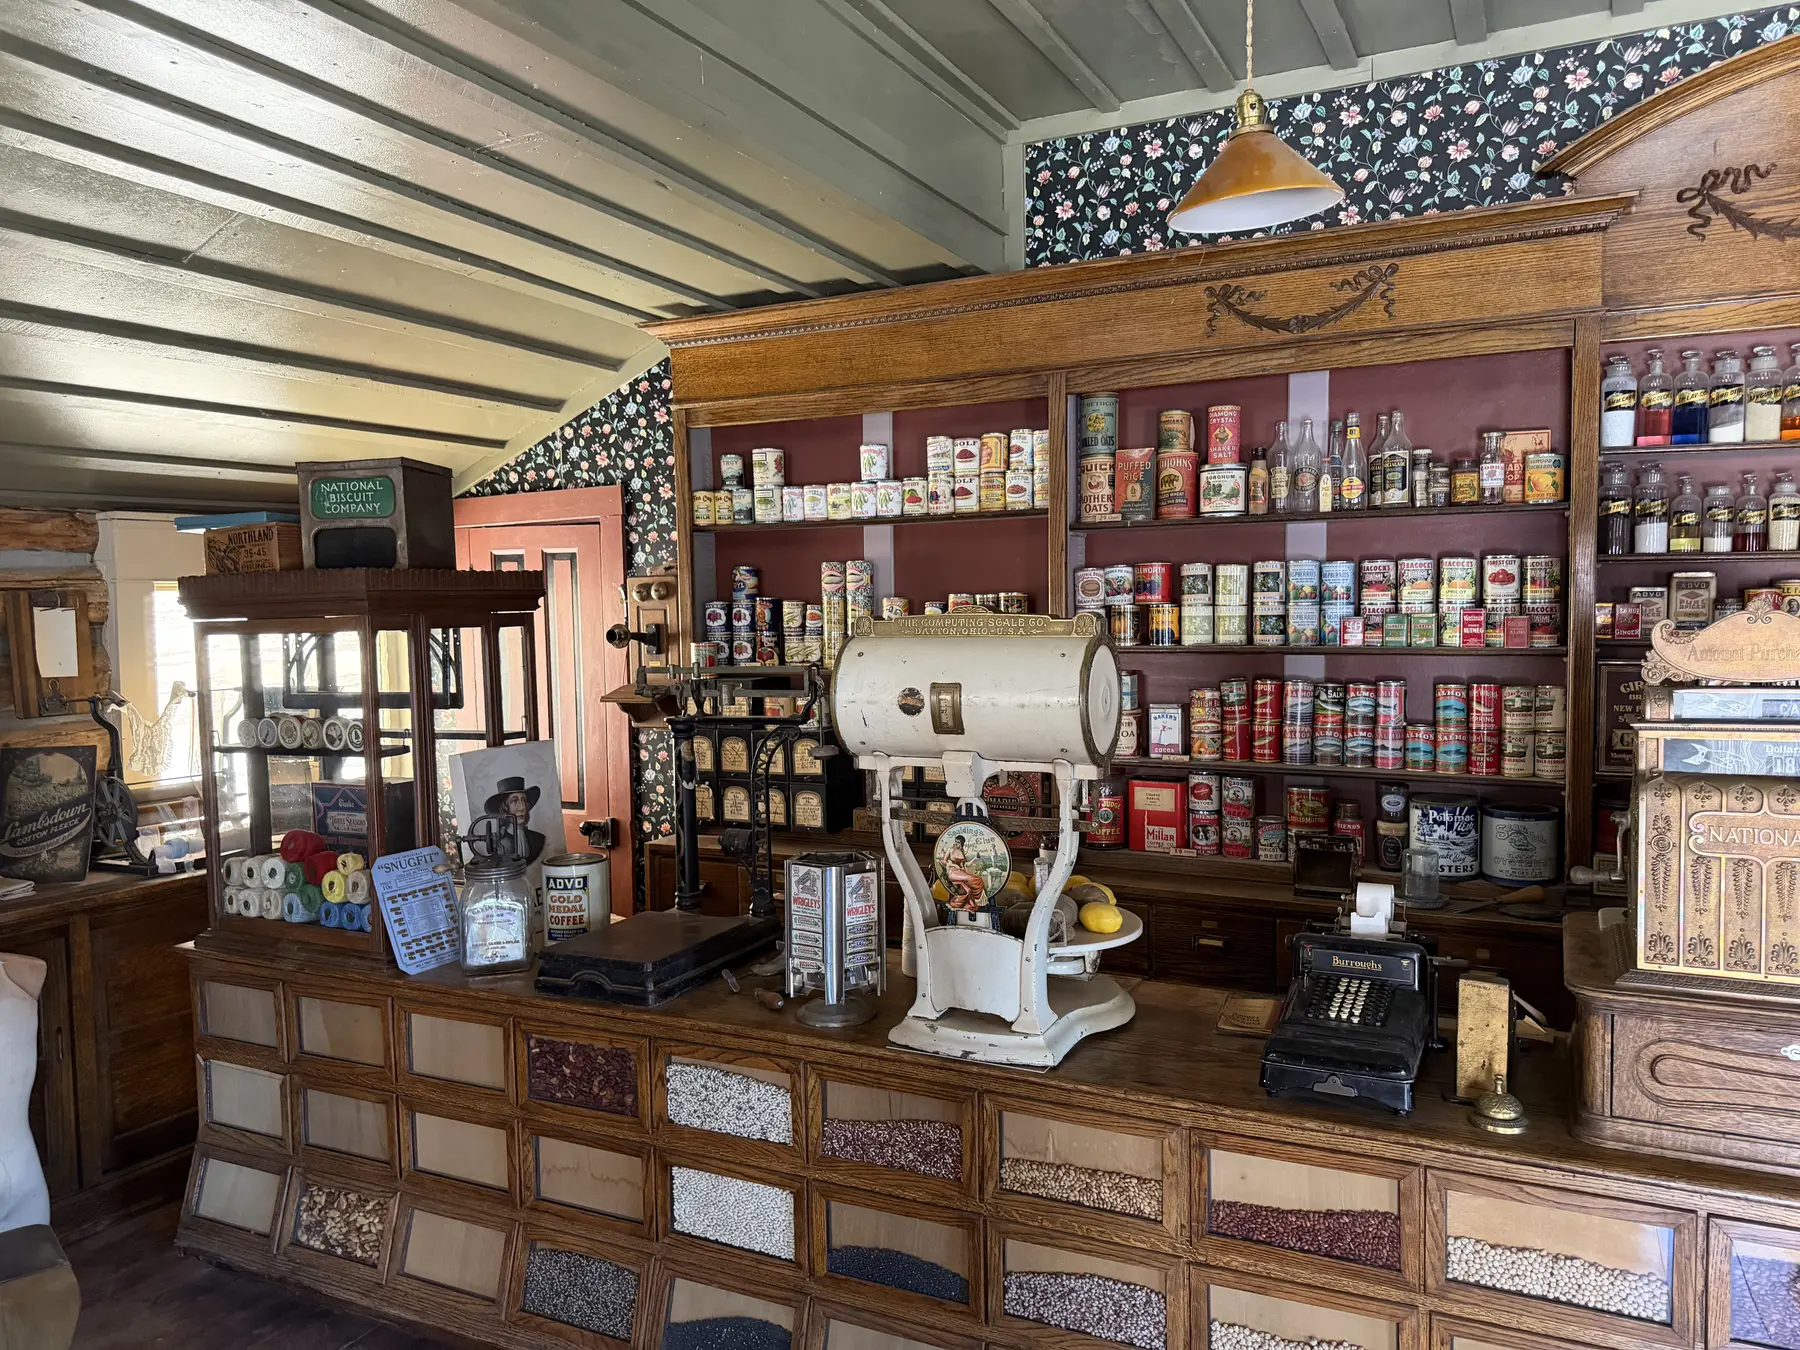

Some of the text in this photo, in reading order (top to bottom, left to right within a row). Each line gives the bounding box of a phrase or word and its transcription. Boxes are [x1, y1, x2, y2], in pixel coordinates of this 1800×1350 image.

[1118, 461, 1151, 471] PUFFED
[1123, 472, 1145, 480] RICE
[321, 481, 383, 493] NATIONAL
[330, 492, 374, 502] BISCUIT
[324, 503, 381, 514] COMPANY
[1084, 503, 1109, 513] OATS
[227, 526, 274, 545] NORTHLAND
[898, 618, 1047, 628] THE COMPUTING SCALE CO.
[915, 628, 959, 636] DAYTON,
[1688, 646, 1746, 662] Amount
[1766, 744, 1800, 753] Dollar
[1102, 800, 1121, 809] JUDGE
[1429, 809, 1475, 824] Potomac
[17, 829, 49, 846] COTTON
[50, 817, 81, 834] FLEECE
[946, 826, 984, 839] Spalding's
[1439, 864, 1475, 873] STERS
[549, 878, 583, 889] ADVO
[550, 895, 583, 904] GOLD
[792, 896, 821, 909] WRIGLEY'S
[549, 904, 586, 913] MEDAL
[847, 904, 876, 917] WRIGLEY'S
[550, 915, 585, 926] COFFEE
[1332, 955, 1383, 971] Burroughs
